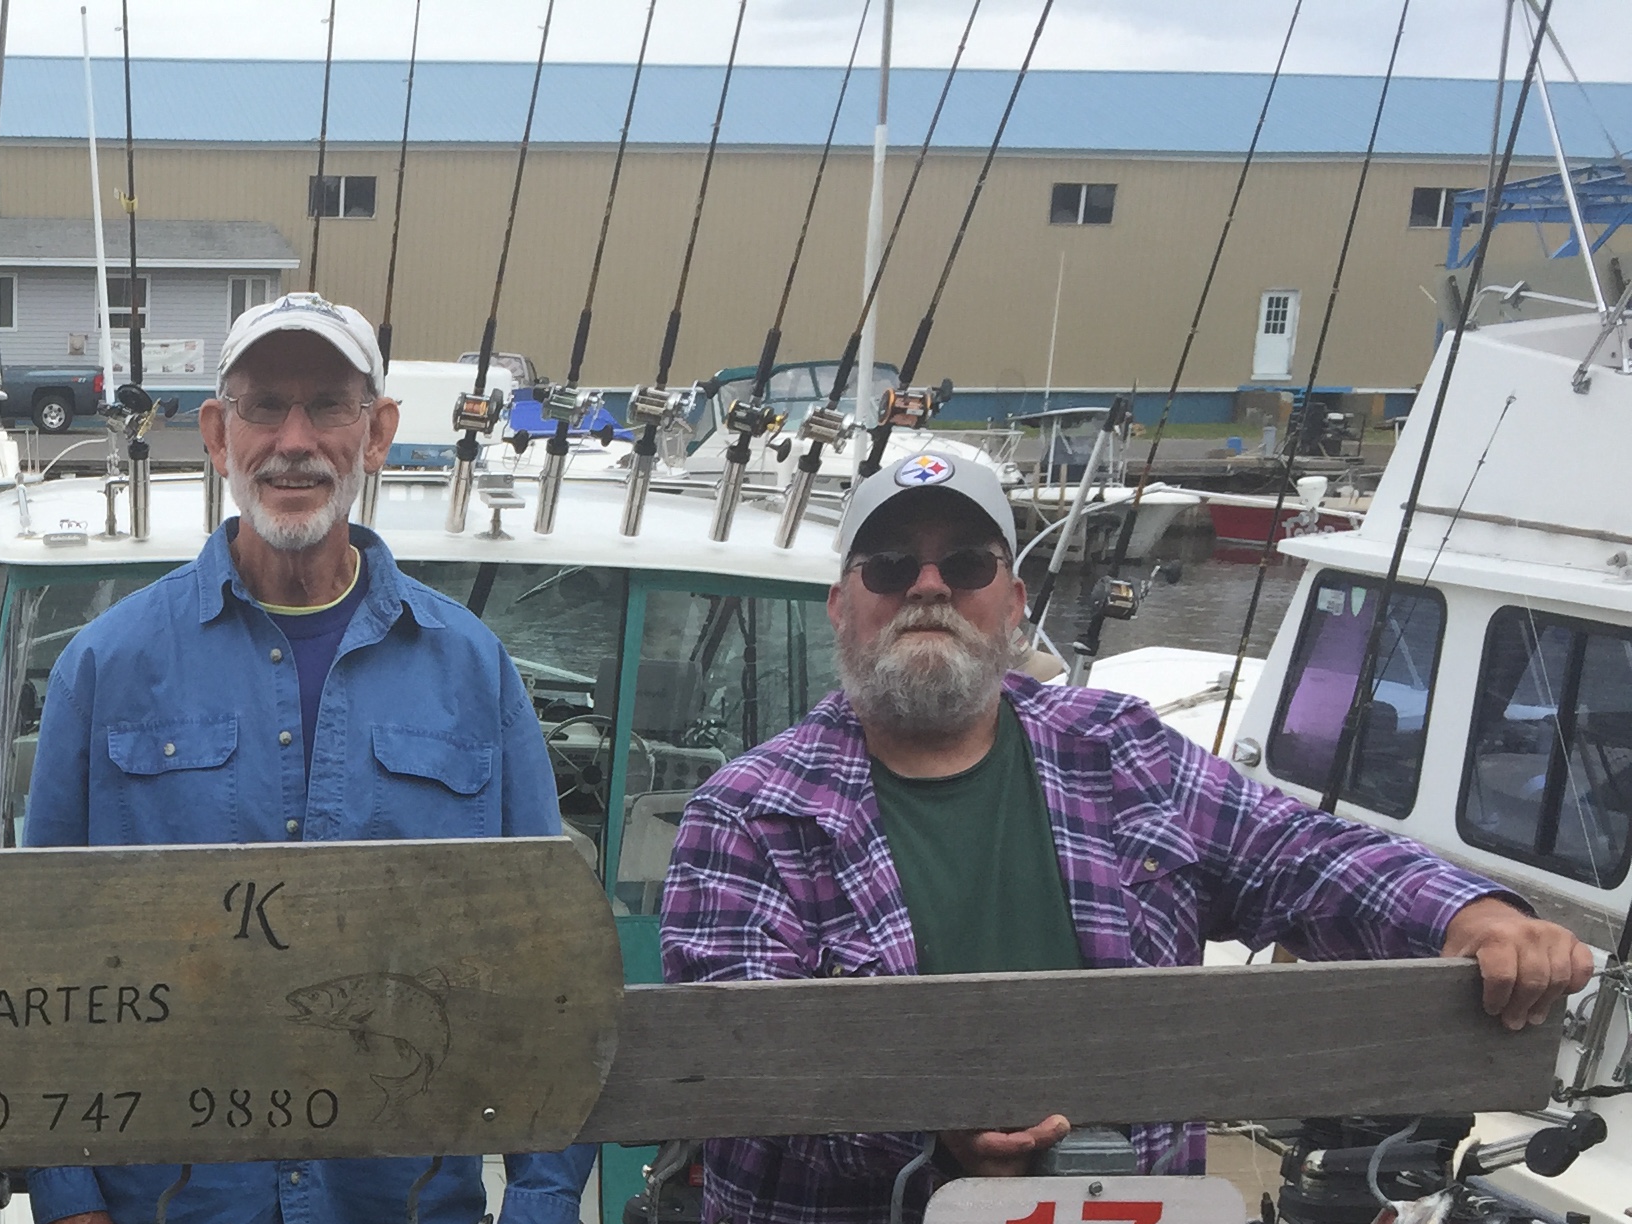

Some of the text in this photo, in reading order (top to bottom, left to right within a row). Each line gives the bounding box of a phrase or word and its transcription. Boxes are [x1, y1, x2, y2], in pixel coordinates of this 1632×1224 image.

[223, 881, 290, 951] K
[42, 1092, 142, 1133] 747
[188, 1087, 338, 1129] 9880
